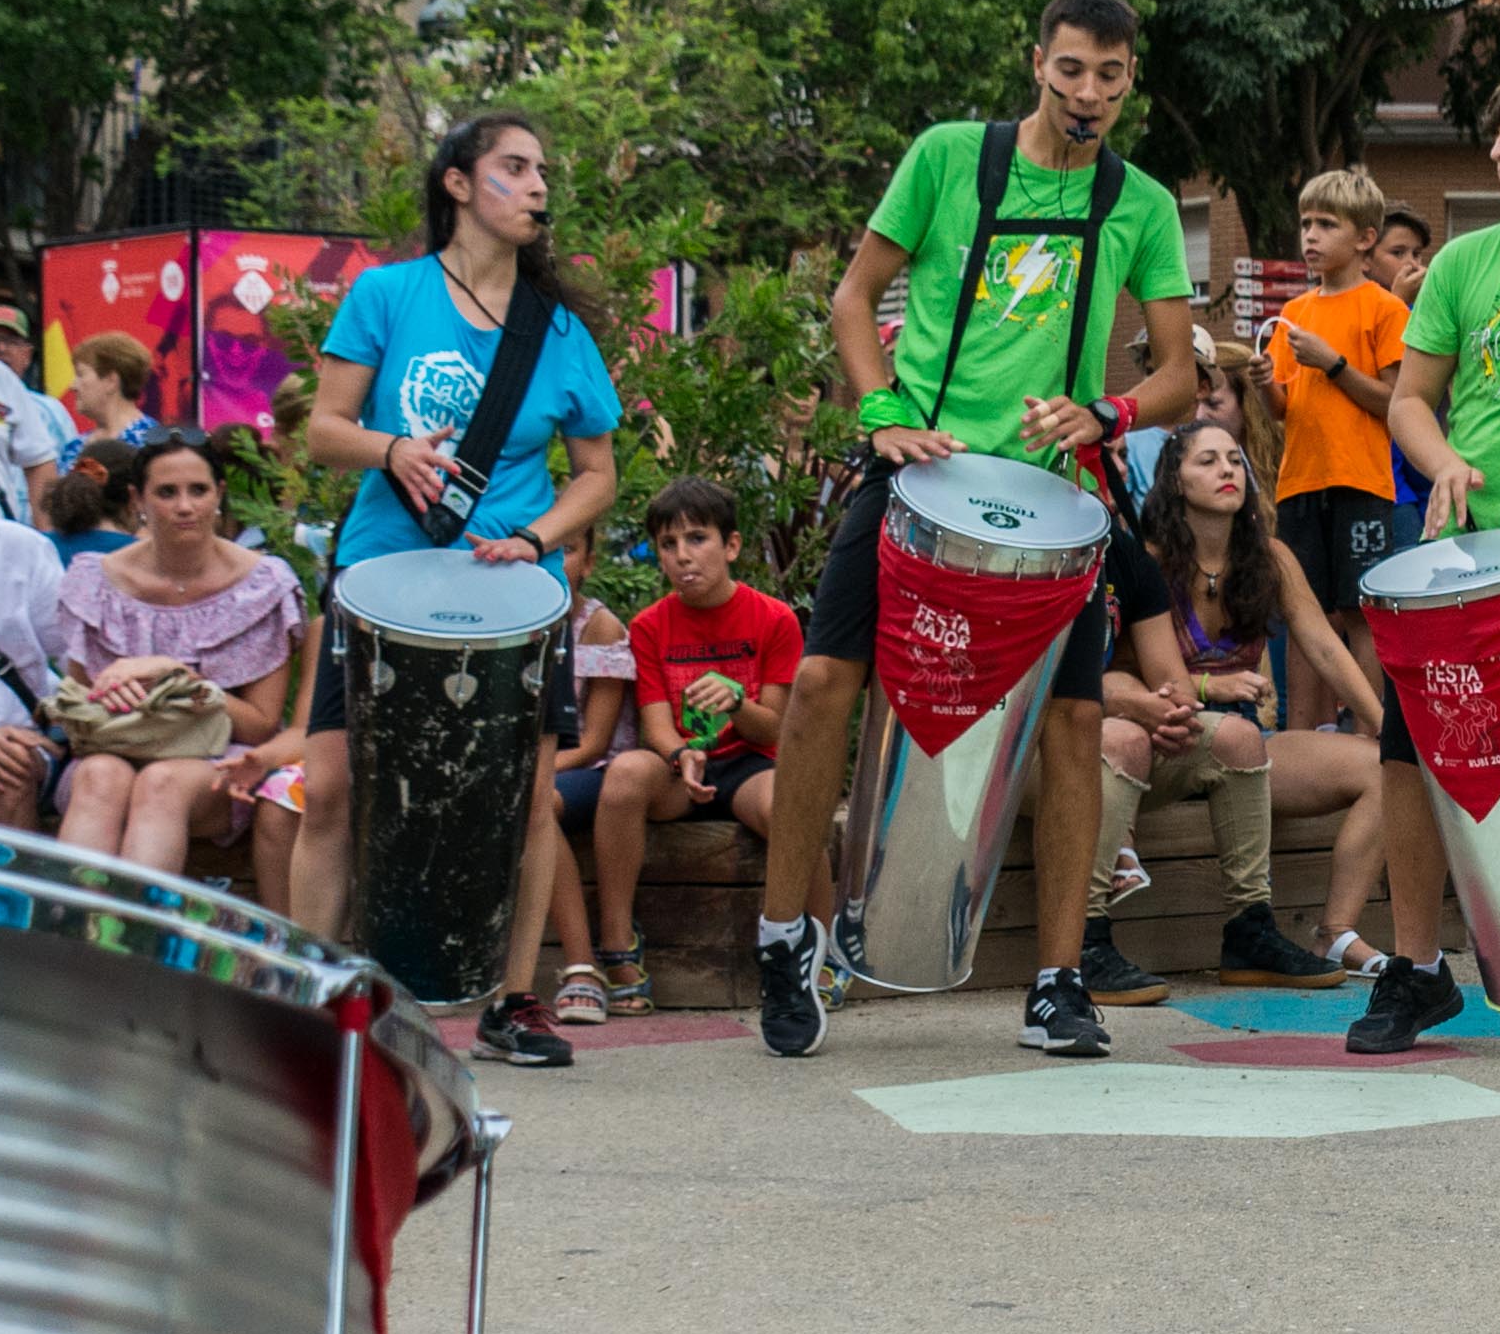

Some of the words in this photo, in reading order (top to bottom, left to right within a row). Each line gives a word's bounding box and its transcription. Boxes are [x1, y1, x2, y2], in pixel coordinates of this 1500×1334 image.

[1351, 520, 1386, 553] 83
[911, 618, 971, 650] MAJOR
[915, 603, 971, 637] FESTA
[1426, 660, 1480, 684] FESTA
